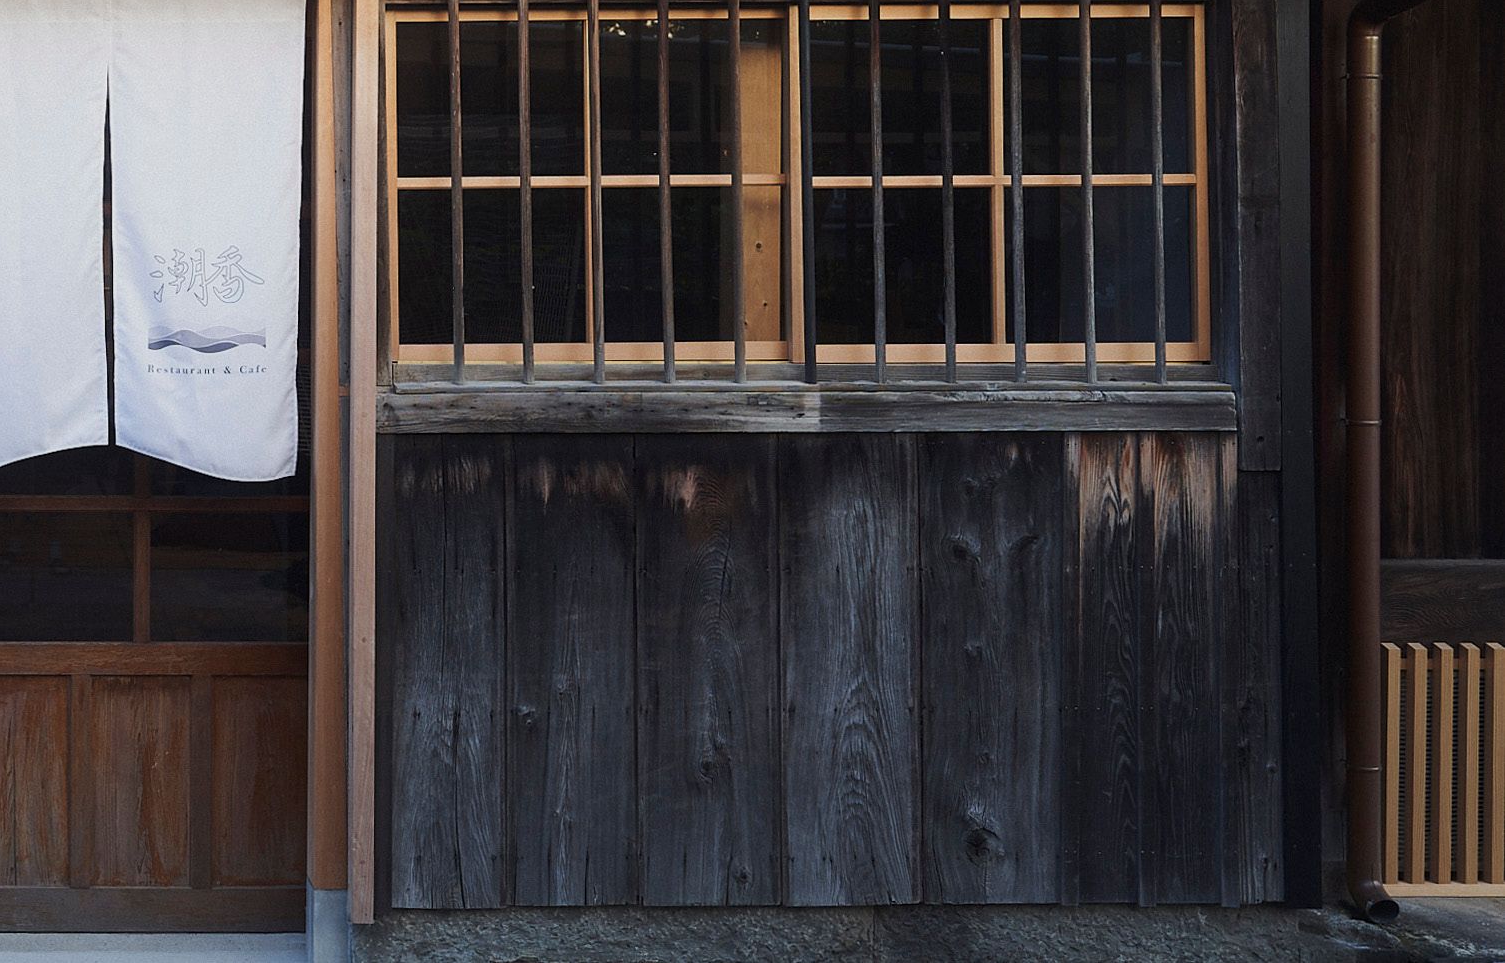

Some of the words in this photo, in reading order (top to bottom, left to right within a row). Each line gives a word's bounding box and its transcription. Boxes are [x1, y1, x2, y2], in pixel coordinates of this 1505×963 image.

[147, 364, 215, 375] Restaurant
[223, 364, 232, 374] &
[239, 364, 267, 374] Cafe
